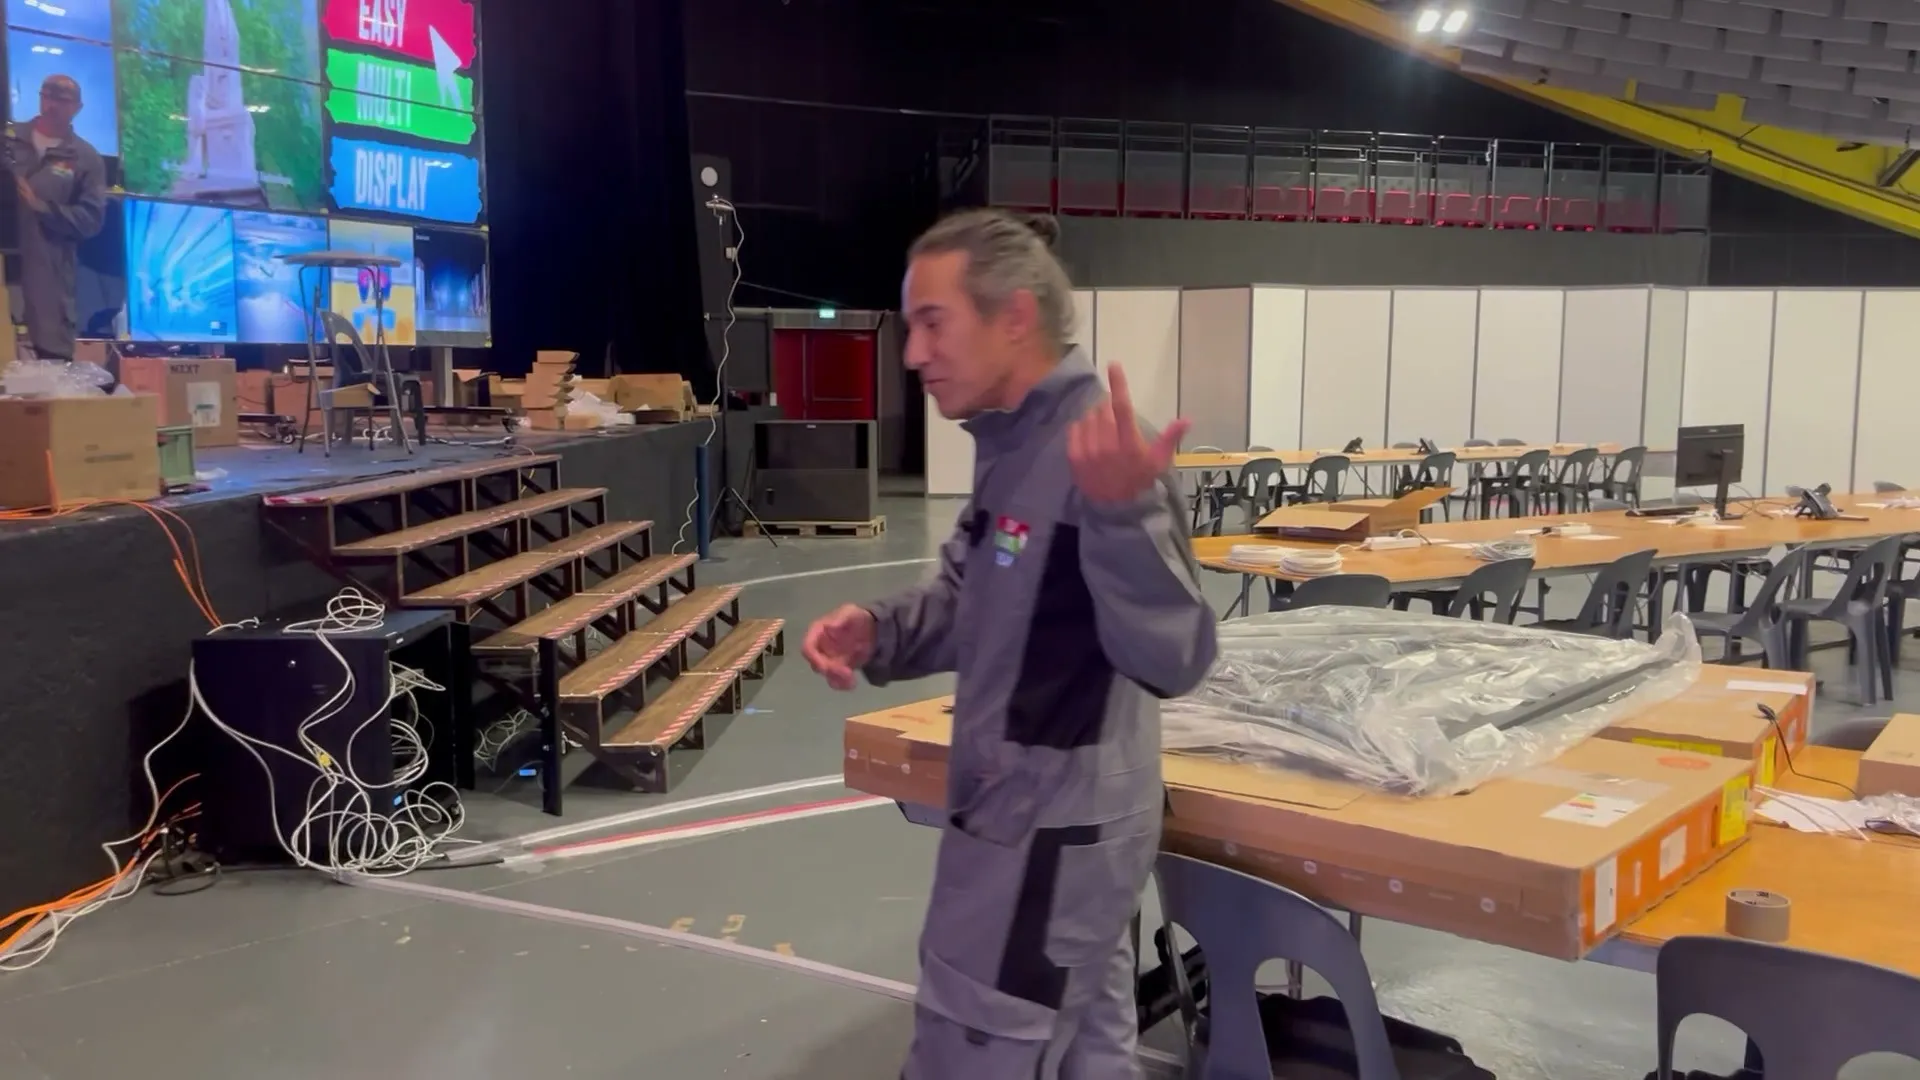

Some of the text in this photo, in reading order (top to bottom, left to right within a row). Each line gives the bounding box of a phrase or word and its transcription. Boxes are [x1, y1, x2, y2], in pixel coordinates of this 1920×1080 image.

[359, 0, 407, 47] EASY
[357, 61, 411, 128] MULTI
[355, 148, 428, 211] DISPLAY
